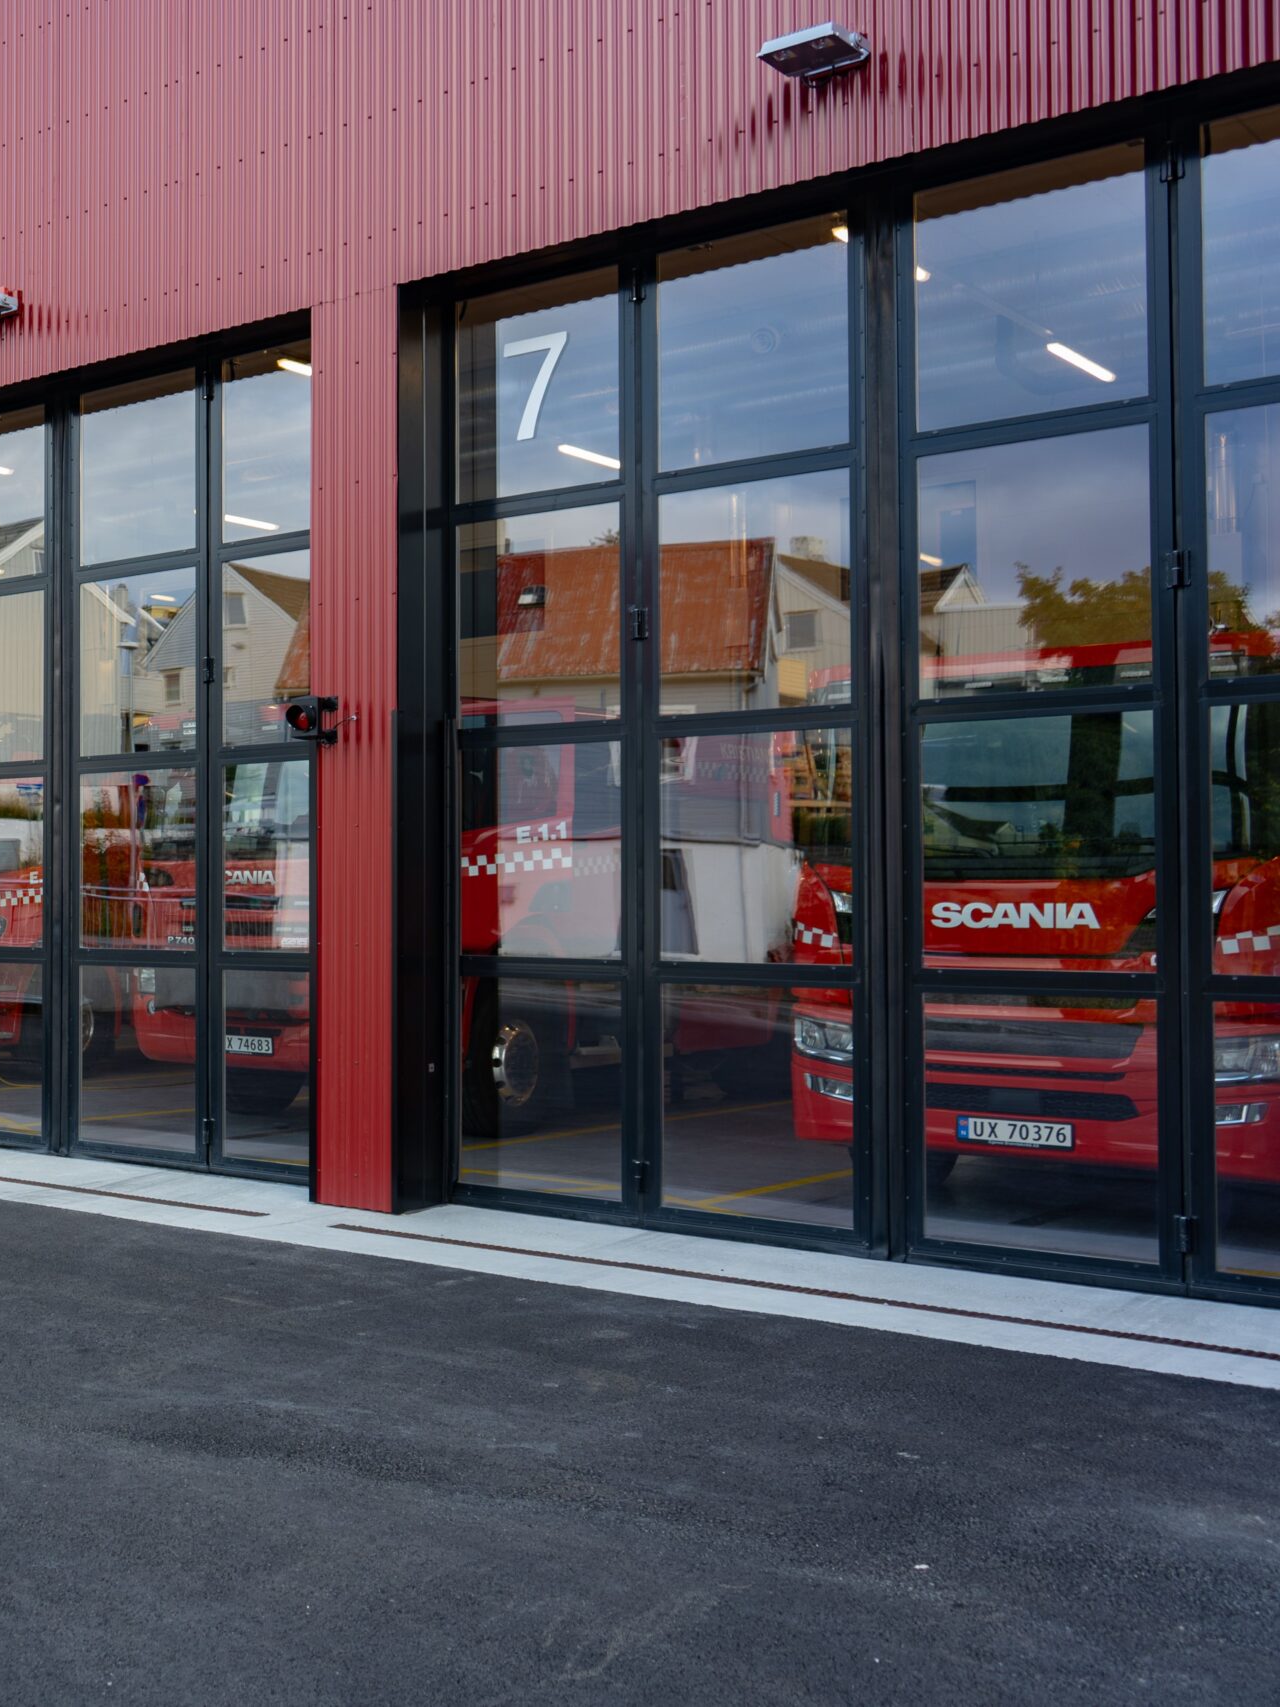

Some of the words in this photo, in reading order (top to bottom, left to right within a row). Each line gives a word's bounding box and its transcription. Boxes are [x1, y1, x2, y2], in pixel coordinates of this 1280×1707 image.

[503, 331, 567, 440] 7
[516, 821, 568, 844] E.1.1
[930, 902, 1101, 929] SCANIA
[237, 1037, 270, 1052] 74683
[973, 1121, 998, 1139] UX
[1007, 1123, 1067, 1143] 70376
